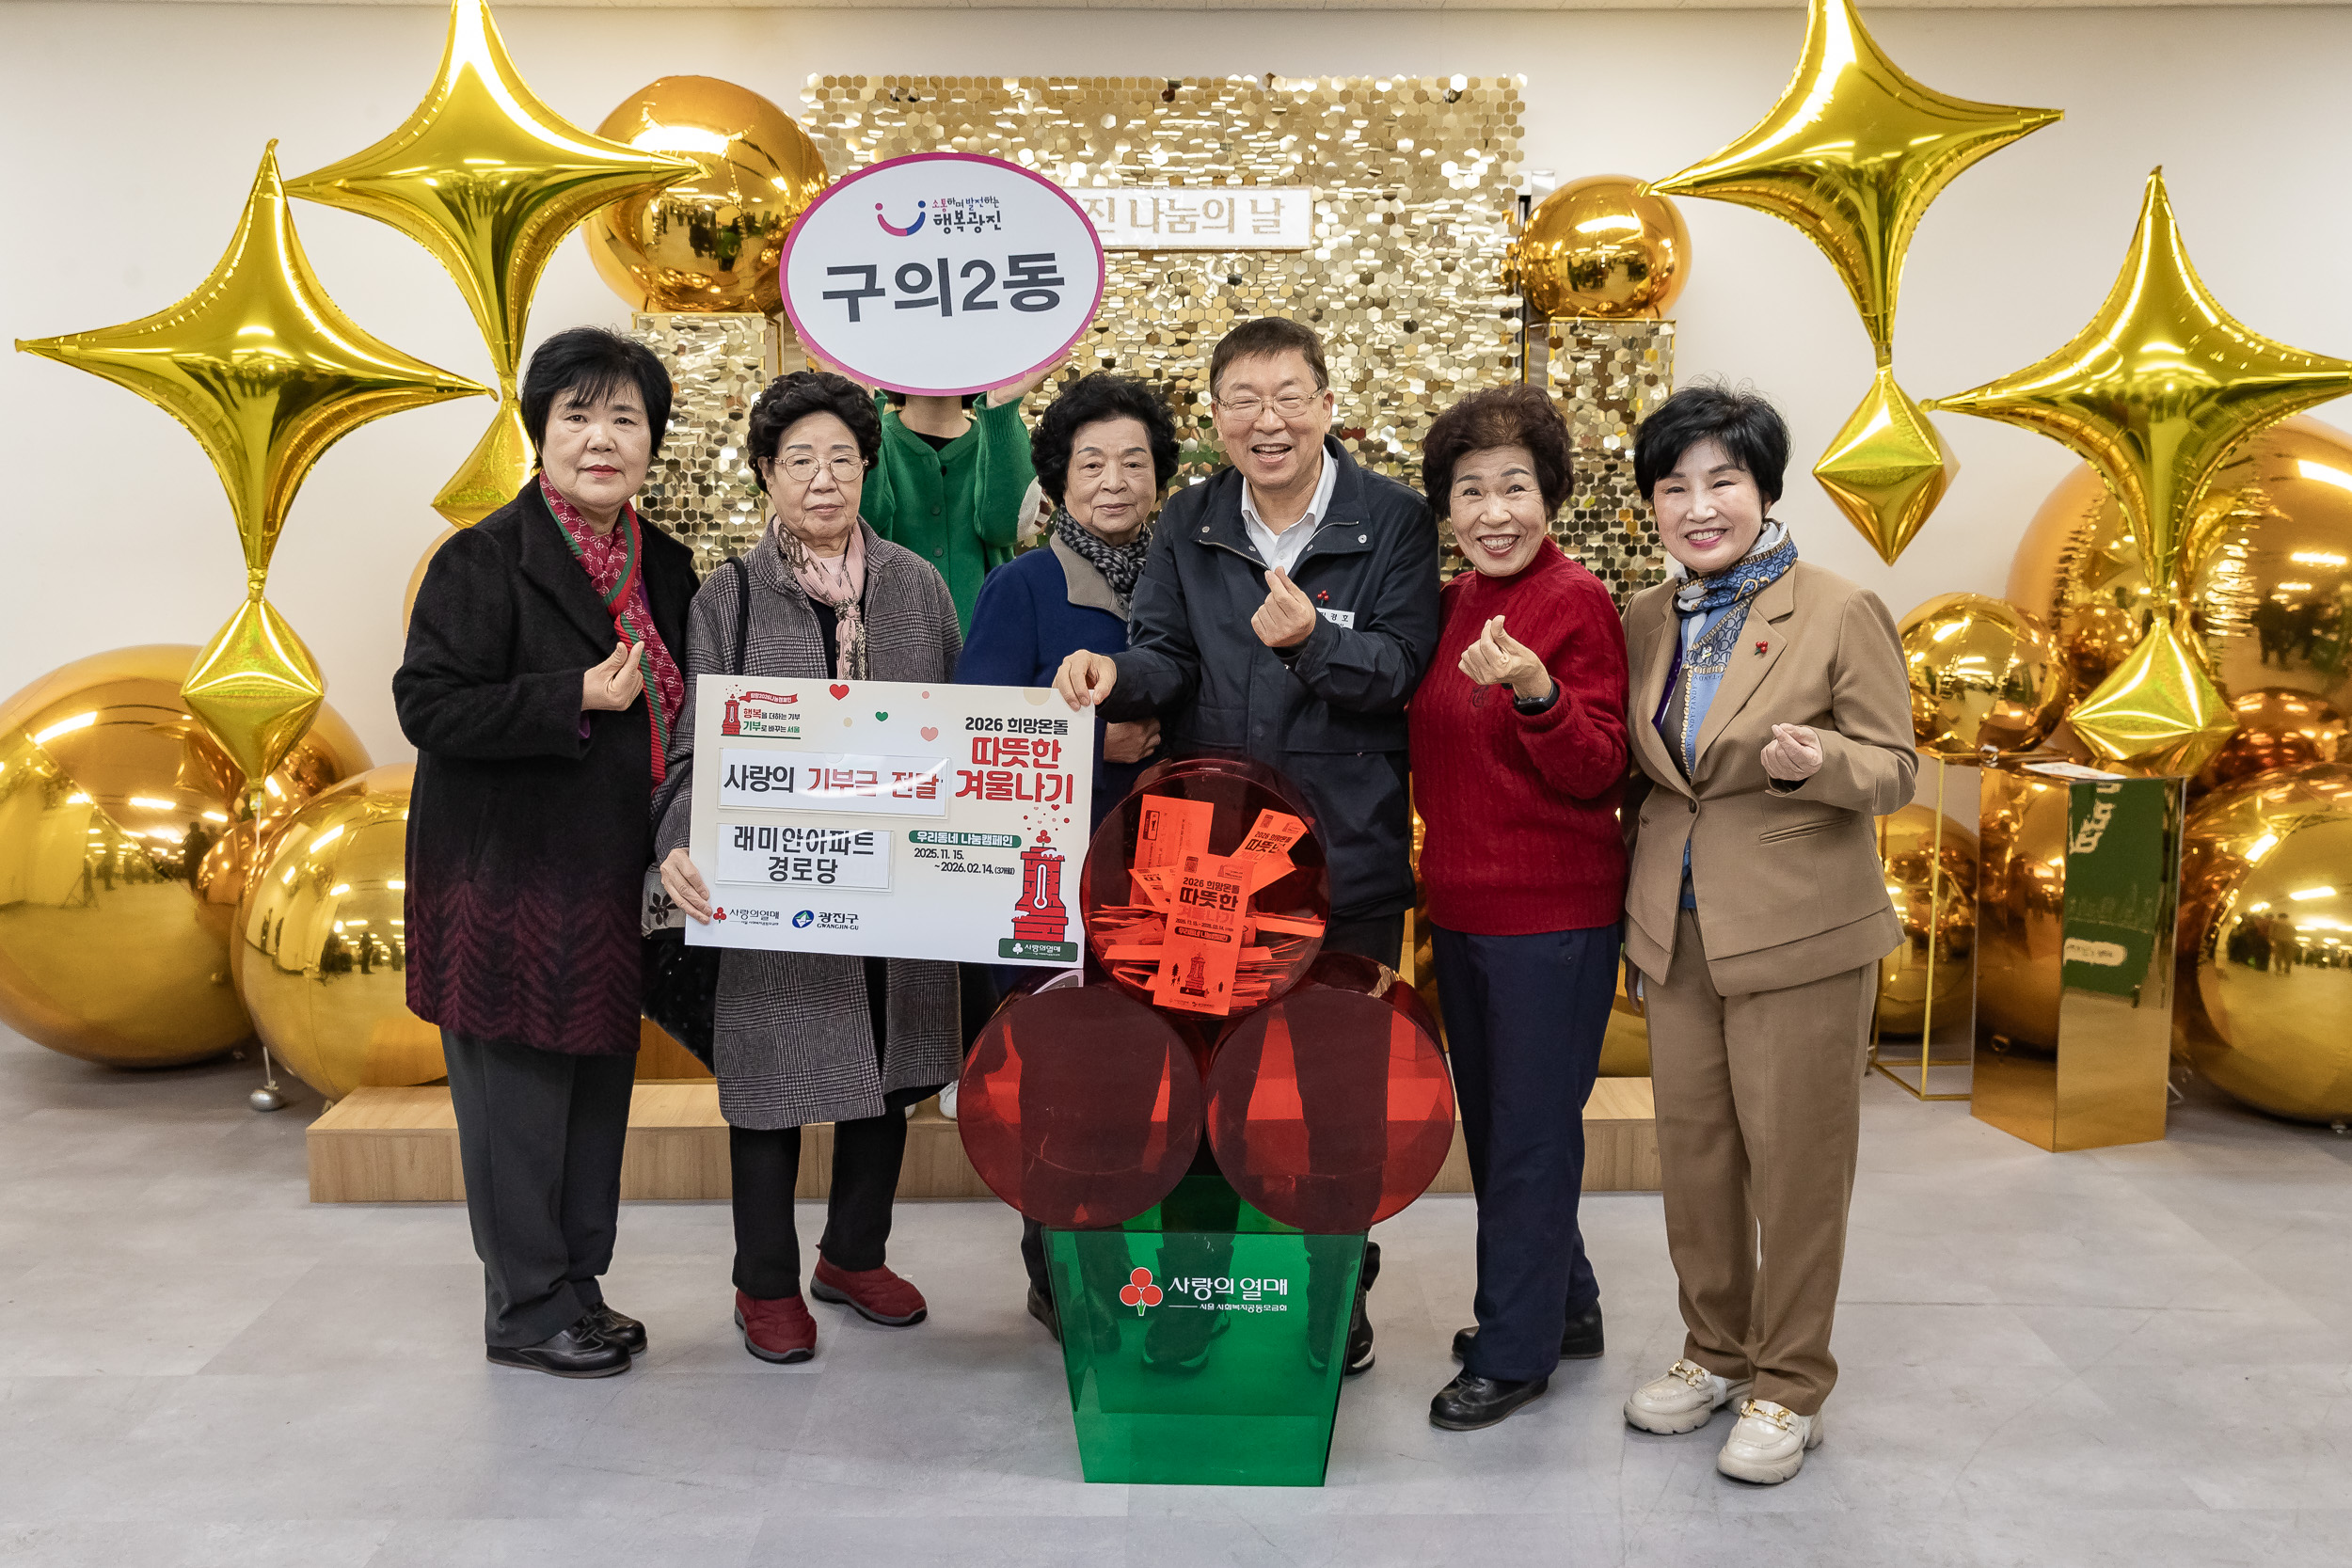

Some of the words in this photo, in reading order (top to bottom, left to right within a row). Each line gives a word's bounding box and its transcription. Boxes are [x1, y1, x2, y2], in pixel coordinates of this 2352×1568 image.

[932, 197, 964, 213] 소통하며
[965, 196, 999, 211] 발전하는
[933, 210, 1001, 234] 행복광진
[1129, 197, 1235, 233] 나눔의
[1249, 197, 1285, 234] 날
[822, 252, 1065, 323] 구의2동
[743, 708, 768, 720] 행복을
[769, 712, 787, 721] 더하는
[742, 721, 768, 733] 기부로
[964, 717, 1004, 732] 2026
[1007, 718, 1069, 736] 희망온돌
[971, 736, 1062, 769] 따뜻한
[723, 764, 795, 793] 사랑의
[891, 770, 940, 800] 전달
[955, 769, 1073, 804] 겨울나기
[734, 826, 875, 855] 래미안아파트
[916, 831, 959, 845] 우리동네
[961, 832, 1014, 847] 나눔캠페인
[914, 847, 940, 859] 2025.
[940, 849, 950, 860] 11.
[952, 849, 964, 860] 15.
[768, 856, 838, 884] 경로당
[966, 863, 981, 874] 02.
[982, 863, 993, 875] 14.
[1183, 877, 1204, 888] 2026
[1179, 887, 1238, 912] 따뜻한
[817, 923, 860, 931] GWANGJIN-GU
[818, 911, 860, 925] 광진구
[1168, 1277, 1234, 1301] 사랑의
[1239, 1277, 1288, 1301] 열매
